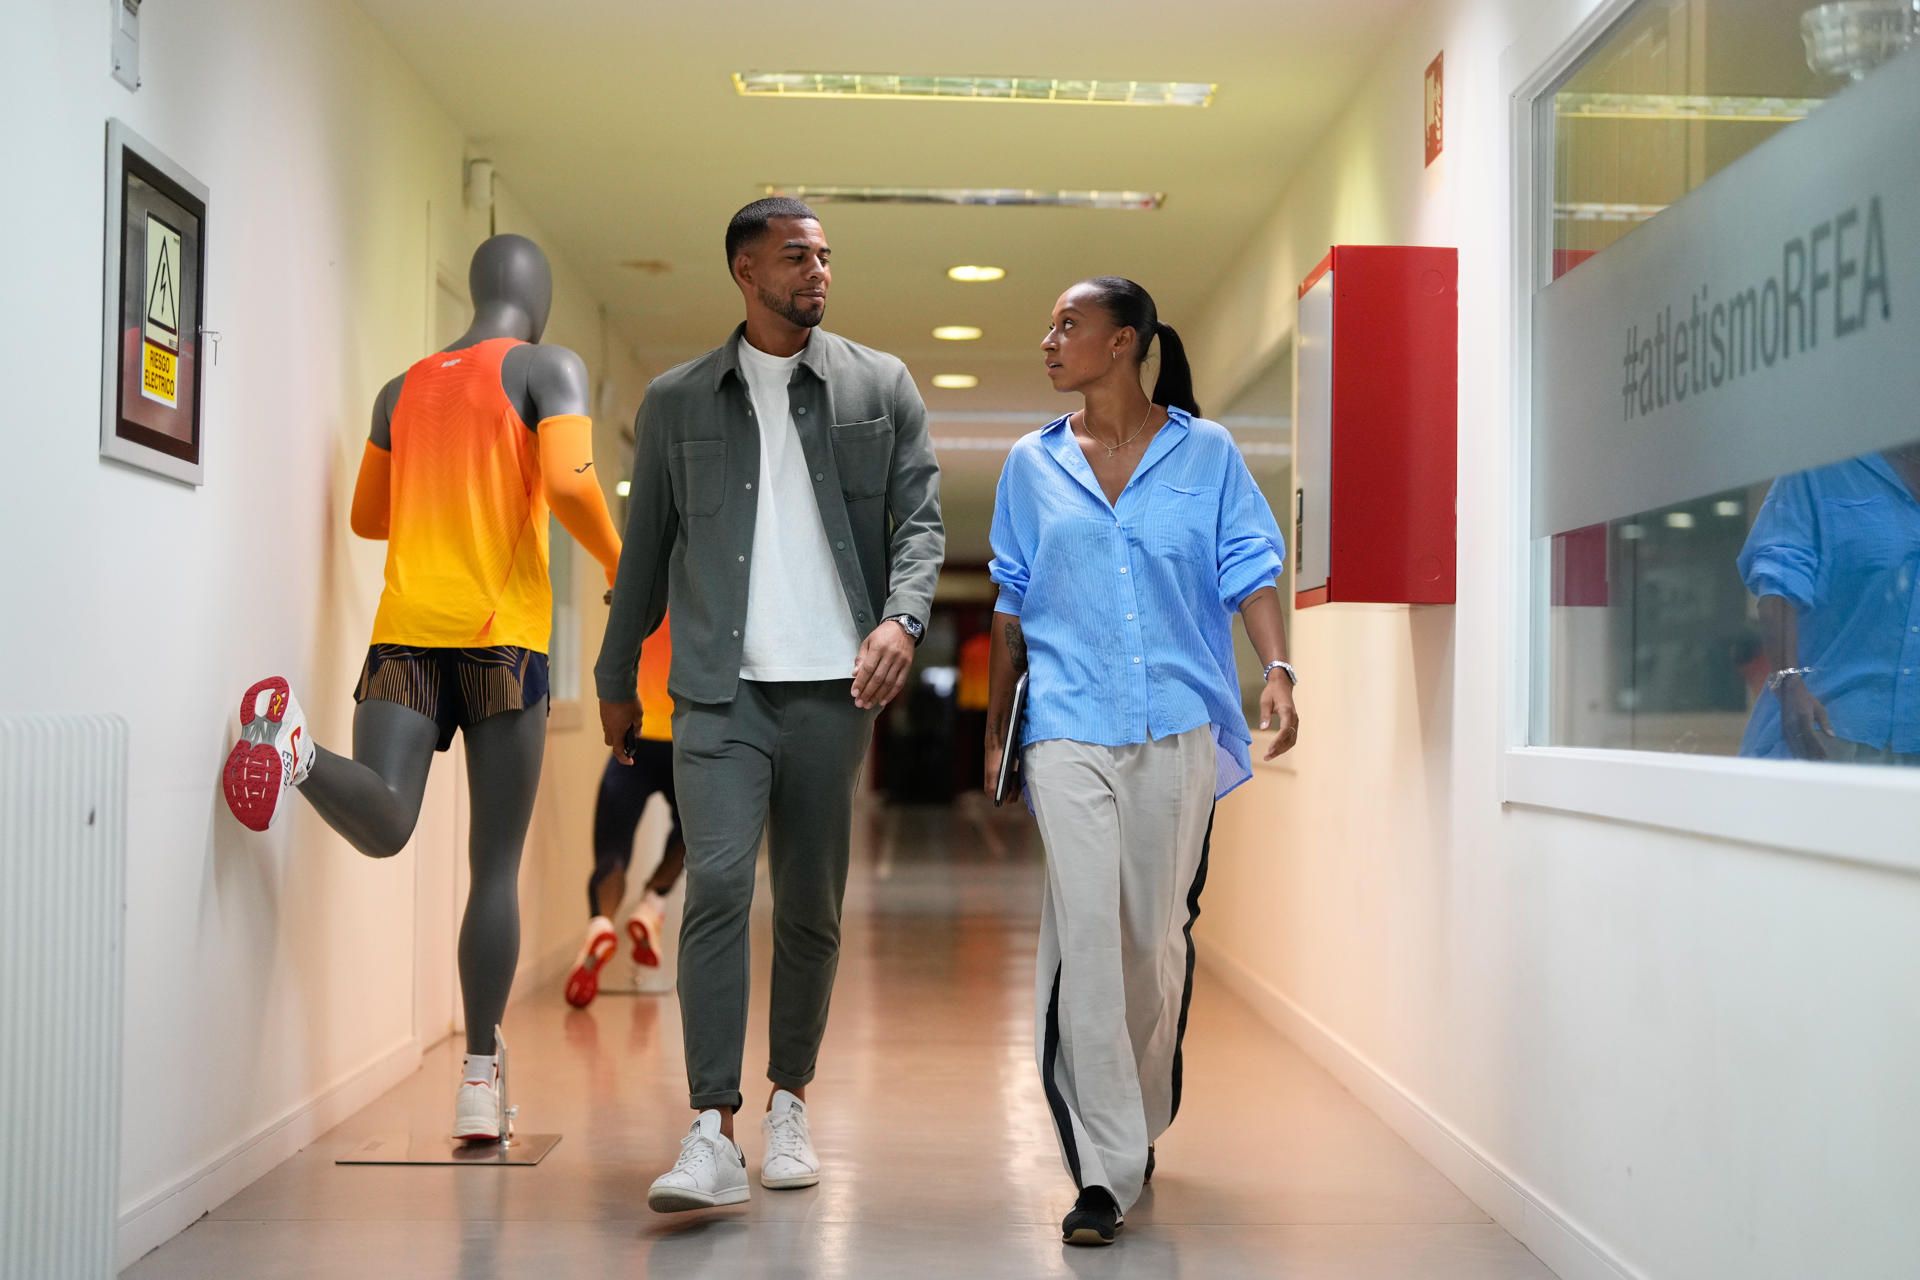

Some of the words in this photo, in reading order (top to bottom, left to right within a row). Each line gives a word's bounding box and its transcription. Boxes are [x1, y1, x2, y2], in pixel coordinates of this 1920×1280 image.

[1622, 194, 1891, 422] #atletismoRFEA
[150, 349, 170, 374] RIESGO
[144, 368, 175, 396] ELECTRICO
